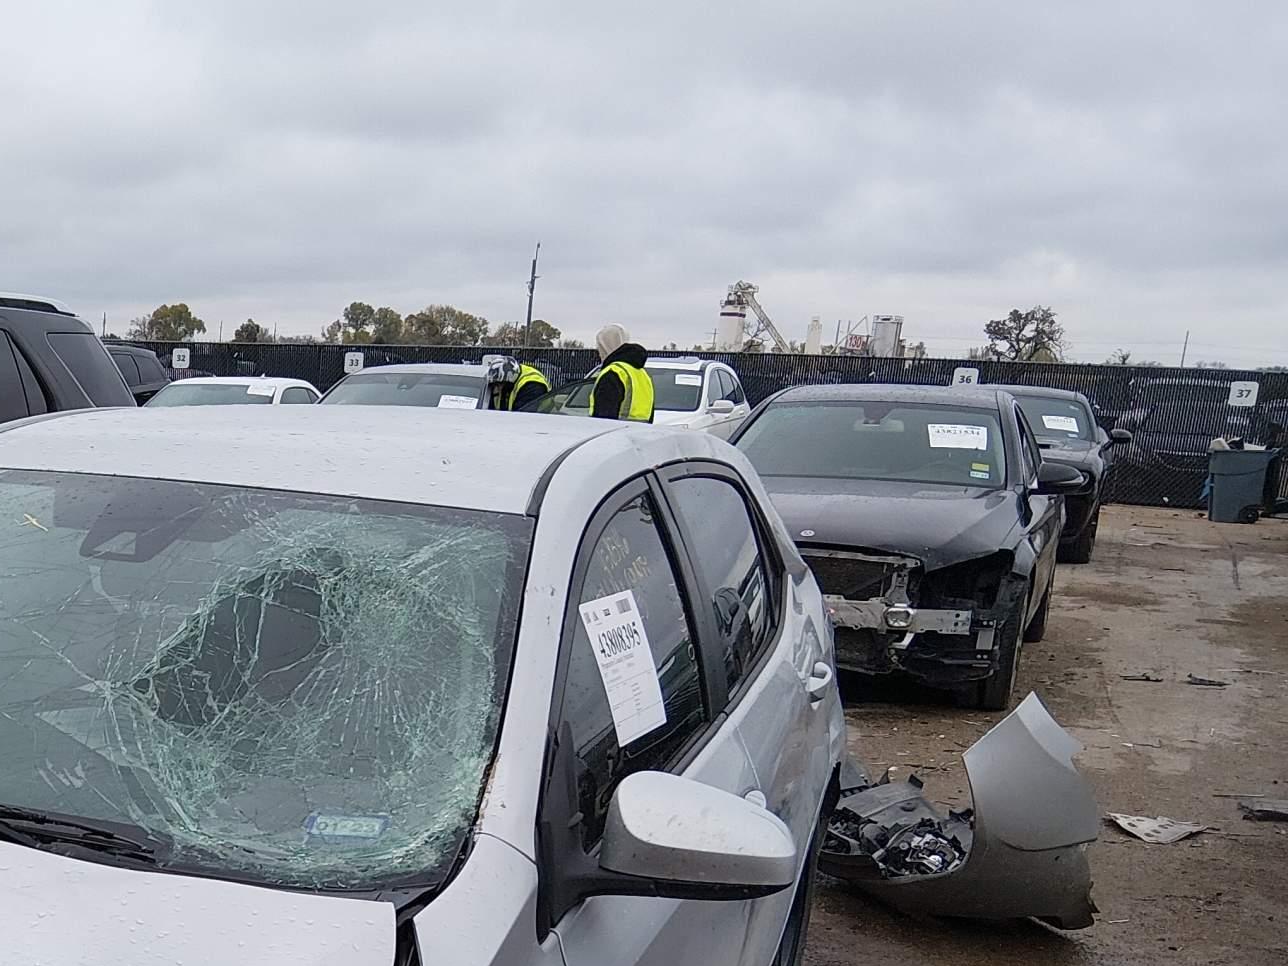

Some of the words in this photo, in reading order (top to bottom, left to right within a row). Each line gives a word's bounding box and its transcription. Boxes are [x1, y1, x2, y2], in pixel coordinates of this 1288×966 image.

[176, 354, 186, 362] 32
[348, 358, 359, 367] 33
[958, 374, 972, 384] 36
[1236, 389, 1252, 398] 37
[598, 621, 641, 659] 43808395
